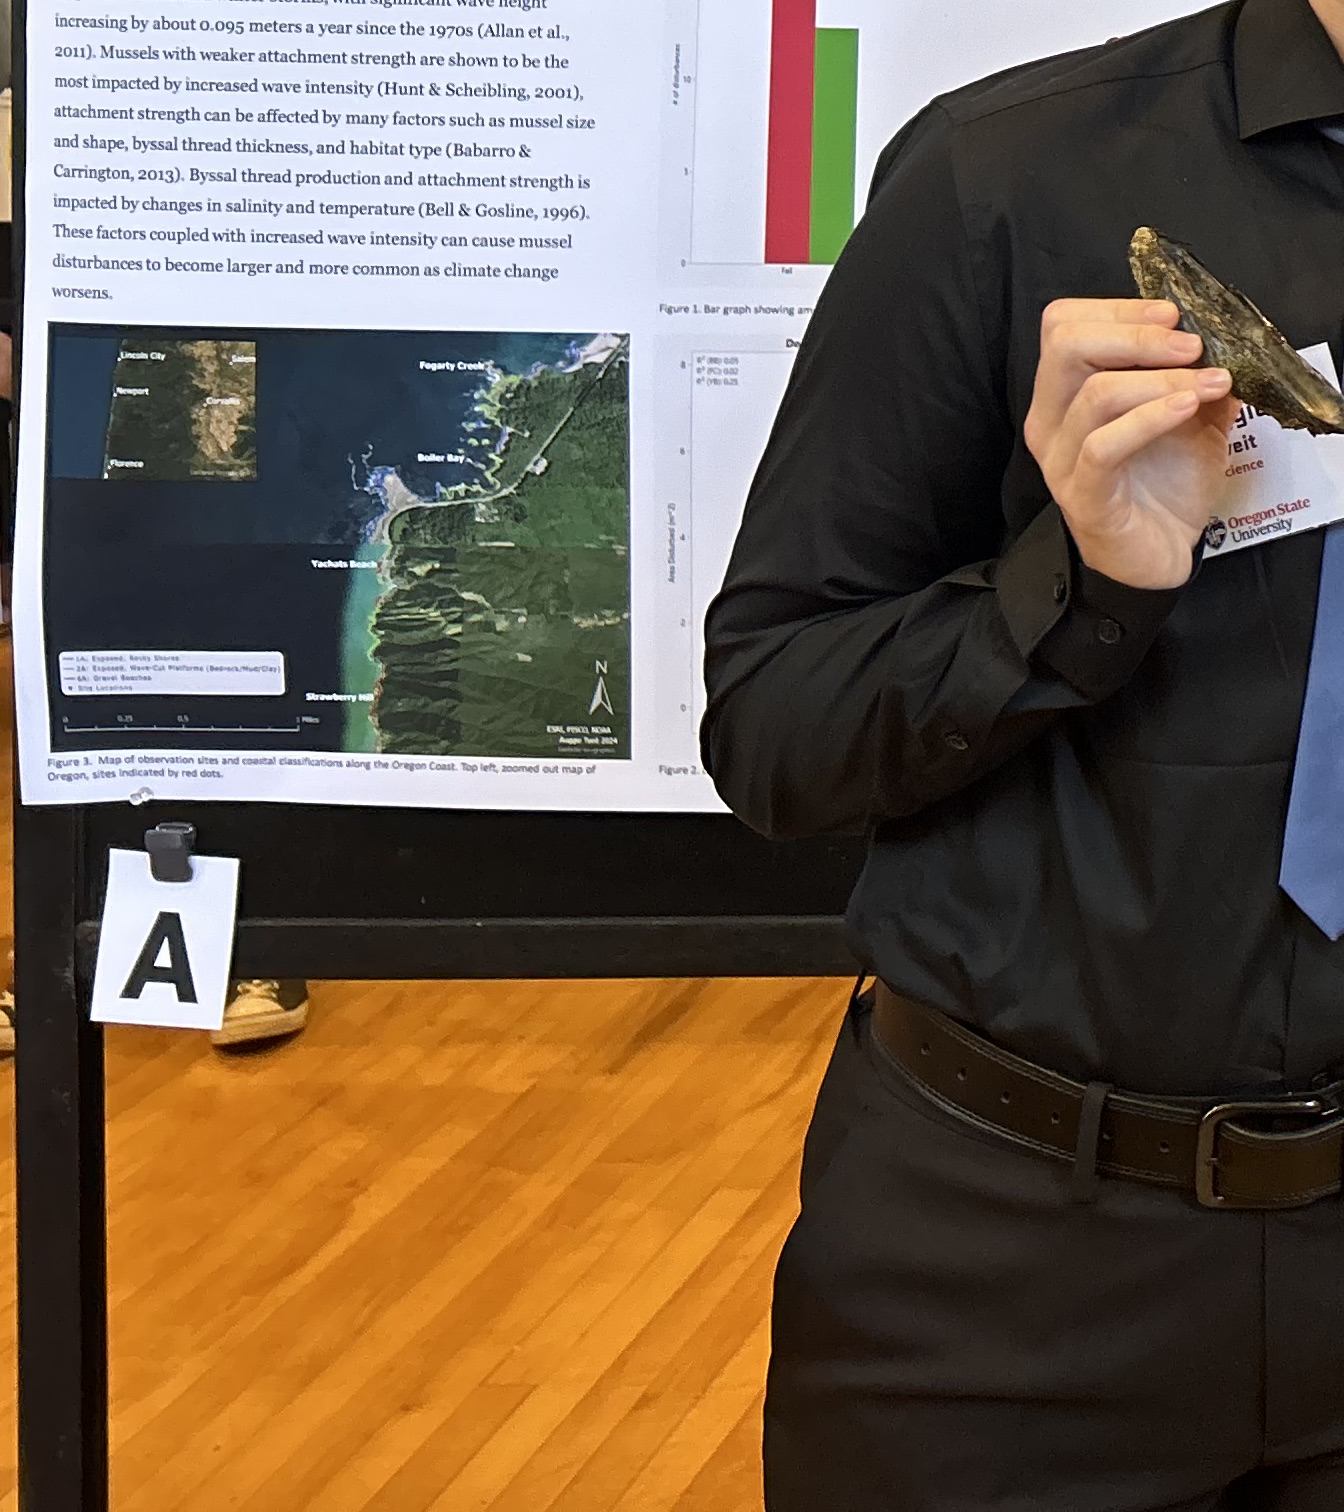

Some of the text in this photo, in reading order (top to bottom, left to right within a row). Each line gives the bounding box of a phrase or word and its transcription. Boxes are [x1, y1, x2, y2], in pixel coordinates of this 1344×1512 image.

[419, 360, 486, 371] Fogarty Creek
[417, 453, 465, 464] Boiler Bay
[1225, 458, 1264, 478] cience
[1228, 497, 1311, 529] Oregon State
[1231, 517, 1293, 543] University
[311, 559, 377, 568] Yachats Beach
[305, 692, 374, 703] Strawberry Hill
[119, 911, 198, 1004] A
